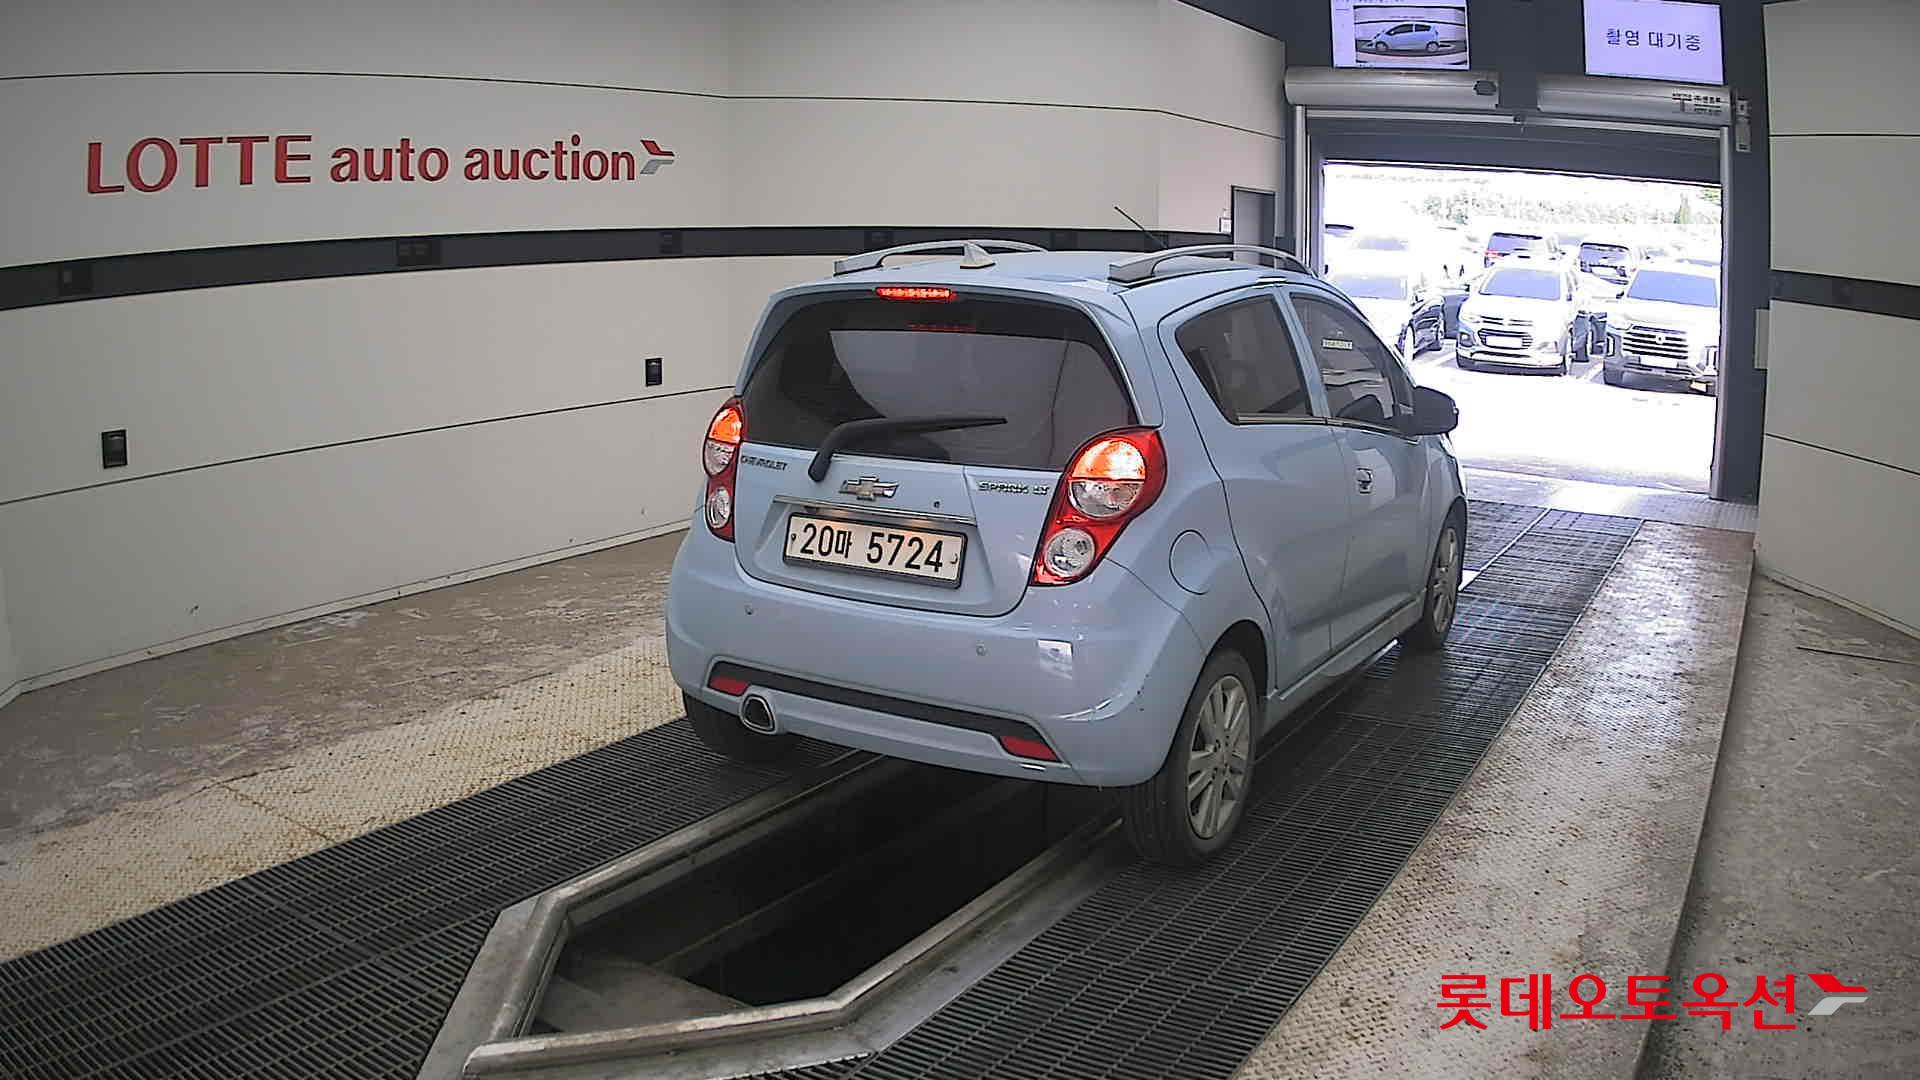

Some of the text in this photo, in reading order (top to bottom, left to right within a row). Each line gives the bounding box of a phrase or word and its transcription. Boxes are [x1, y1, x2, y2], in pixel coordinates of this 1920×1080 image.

[1606, 28, 1640, 47] 촬영
[88, 133, 637, 193] LOTTE auto auction
[800, 522, 943, 573] 20마 5724
